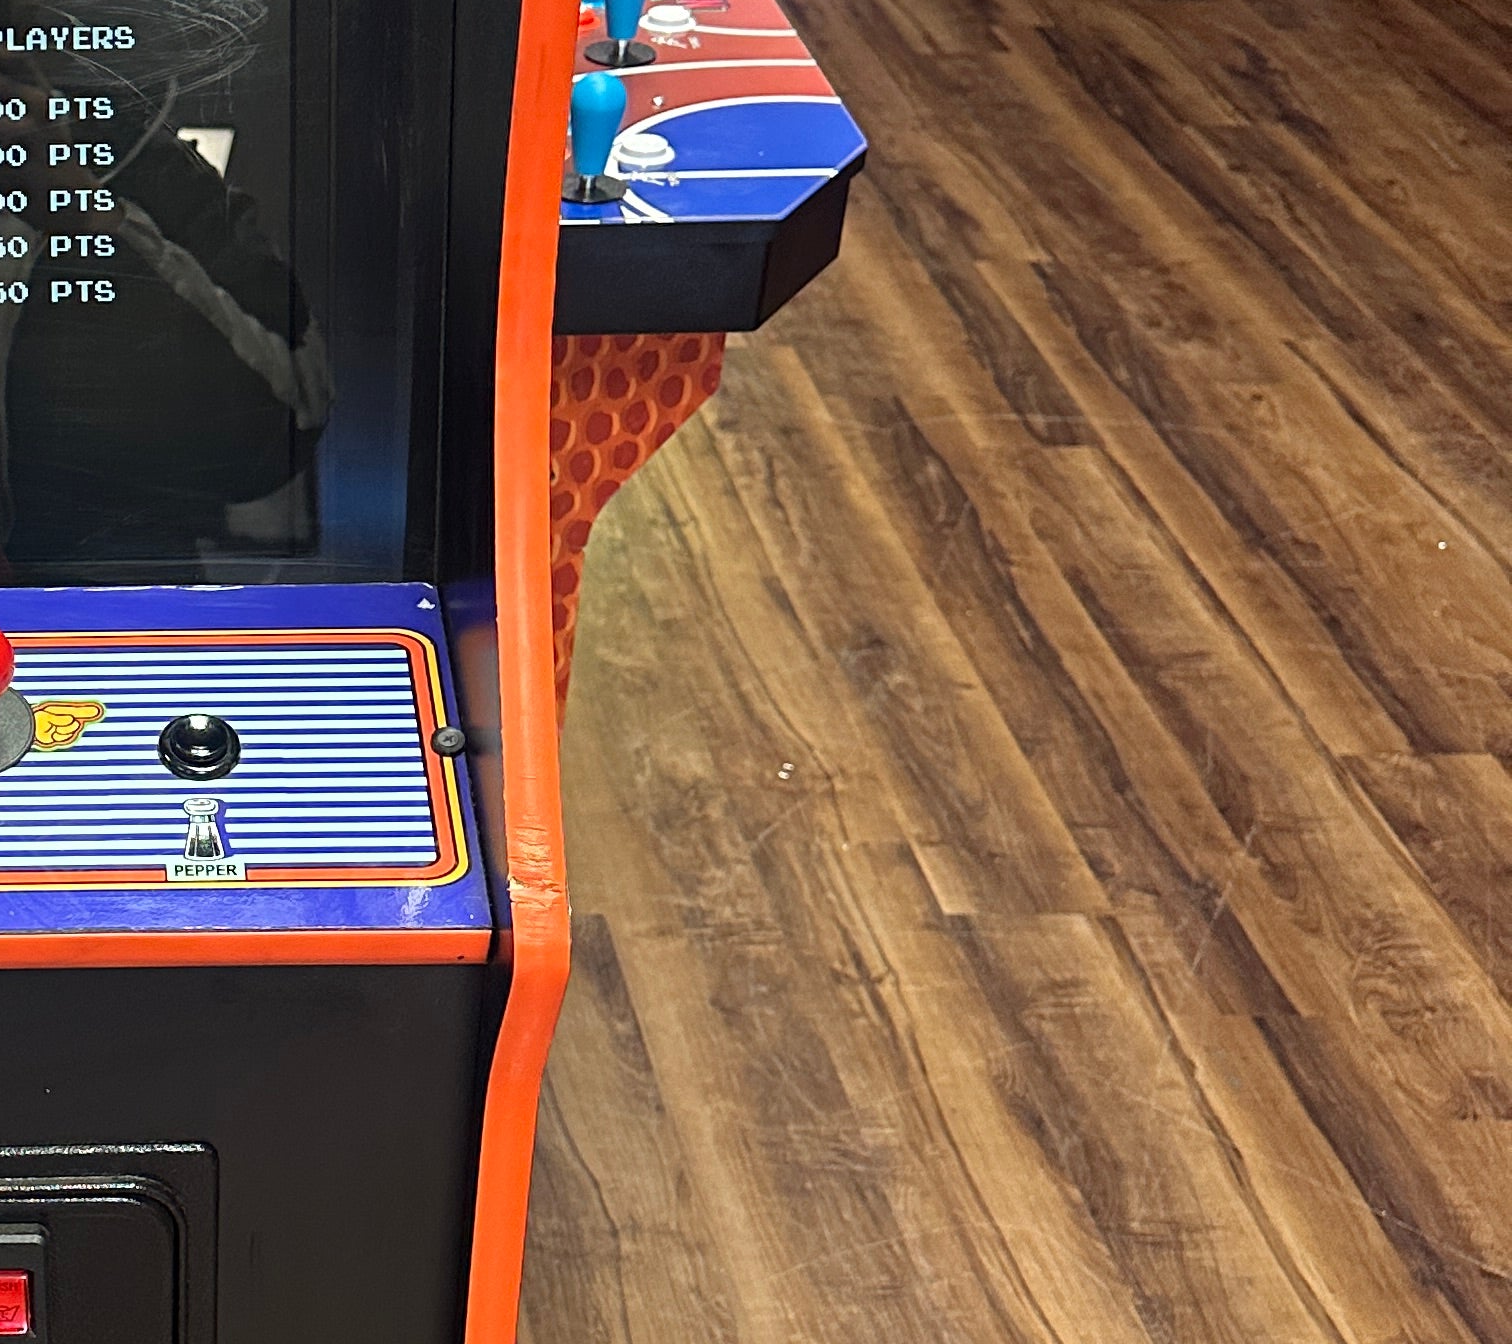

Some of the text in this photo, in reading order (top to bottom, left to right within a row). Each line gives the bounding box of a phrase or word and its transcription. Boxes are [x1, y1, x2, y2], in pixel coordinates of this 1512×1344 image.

[49, 97, 115, 120] PTS
[49, 143, 115, 166] PTS
[50, 189, 116, 212] PTS
[50, 234, 116, 257] PTS
[50, 280, 116, 303] PTS
[174, 864, 238, 877] PEPPER
